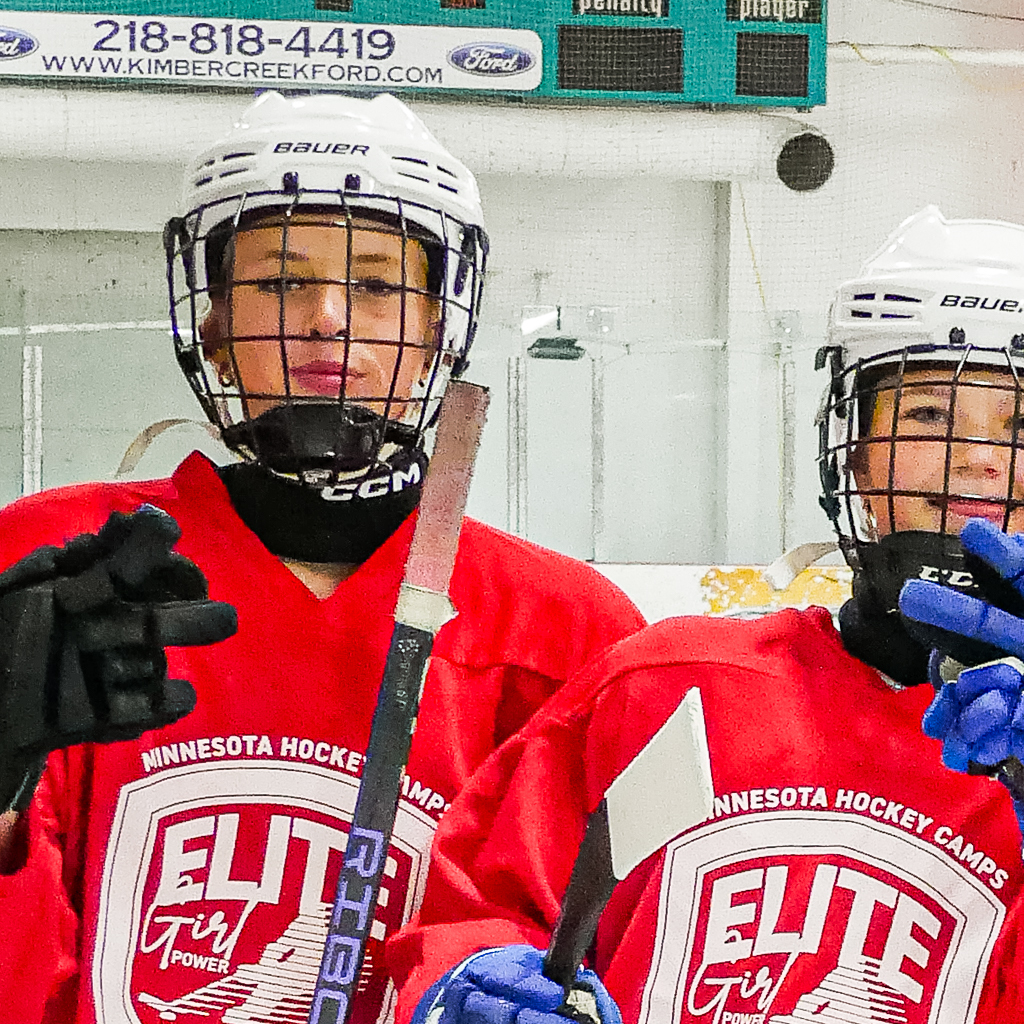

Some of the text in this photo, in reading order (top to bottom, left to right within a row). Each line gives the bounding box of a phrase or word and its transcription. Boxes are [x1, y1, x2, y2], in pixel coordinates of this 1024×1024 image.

[93, 20, 396, 61] 218-818-4419
[41, 54, 444, 84] WWW.KIMBERCREEKFORD.COM
[464, 47, 518, 73] Ford
[273, 142, 370, 156] BAUER
[320, 461, 421, 502] CCM
[141, 735, 274, 773] MINNESOTA
[280, 736, 367, 773] HOCKE
[709, 786, 1009, 890] NNESOTA HOCKEY CAMPS
[702, 863, 942, 1004] ELITE
[170, 949, 230, 975] POWER
